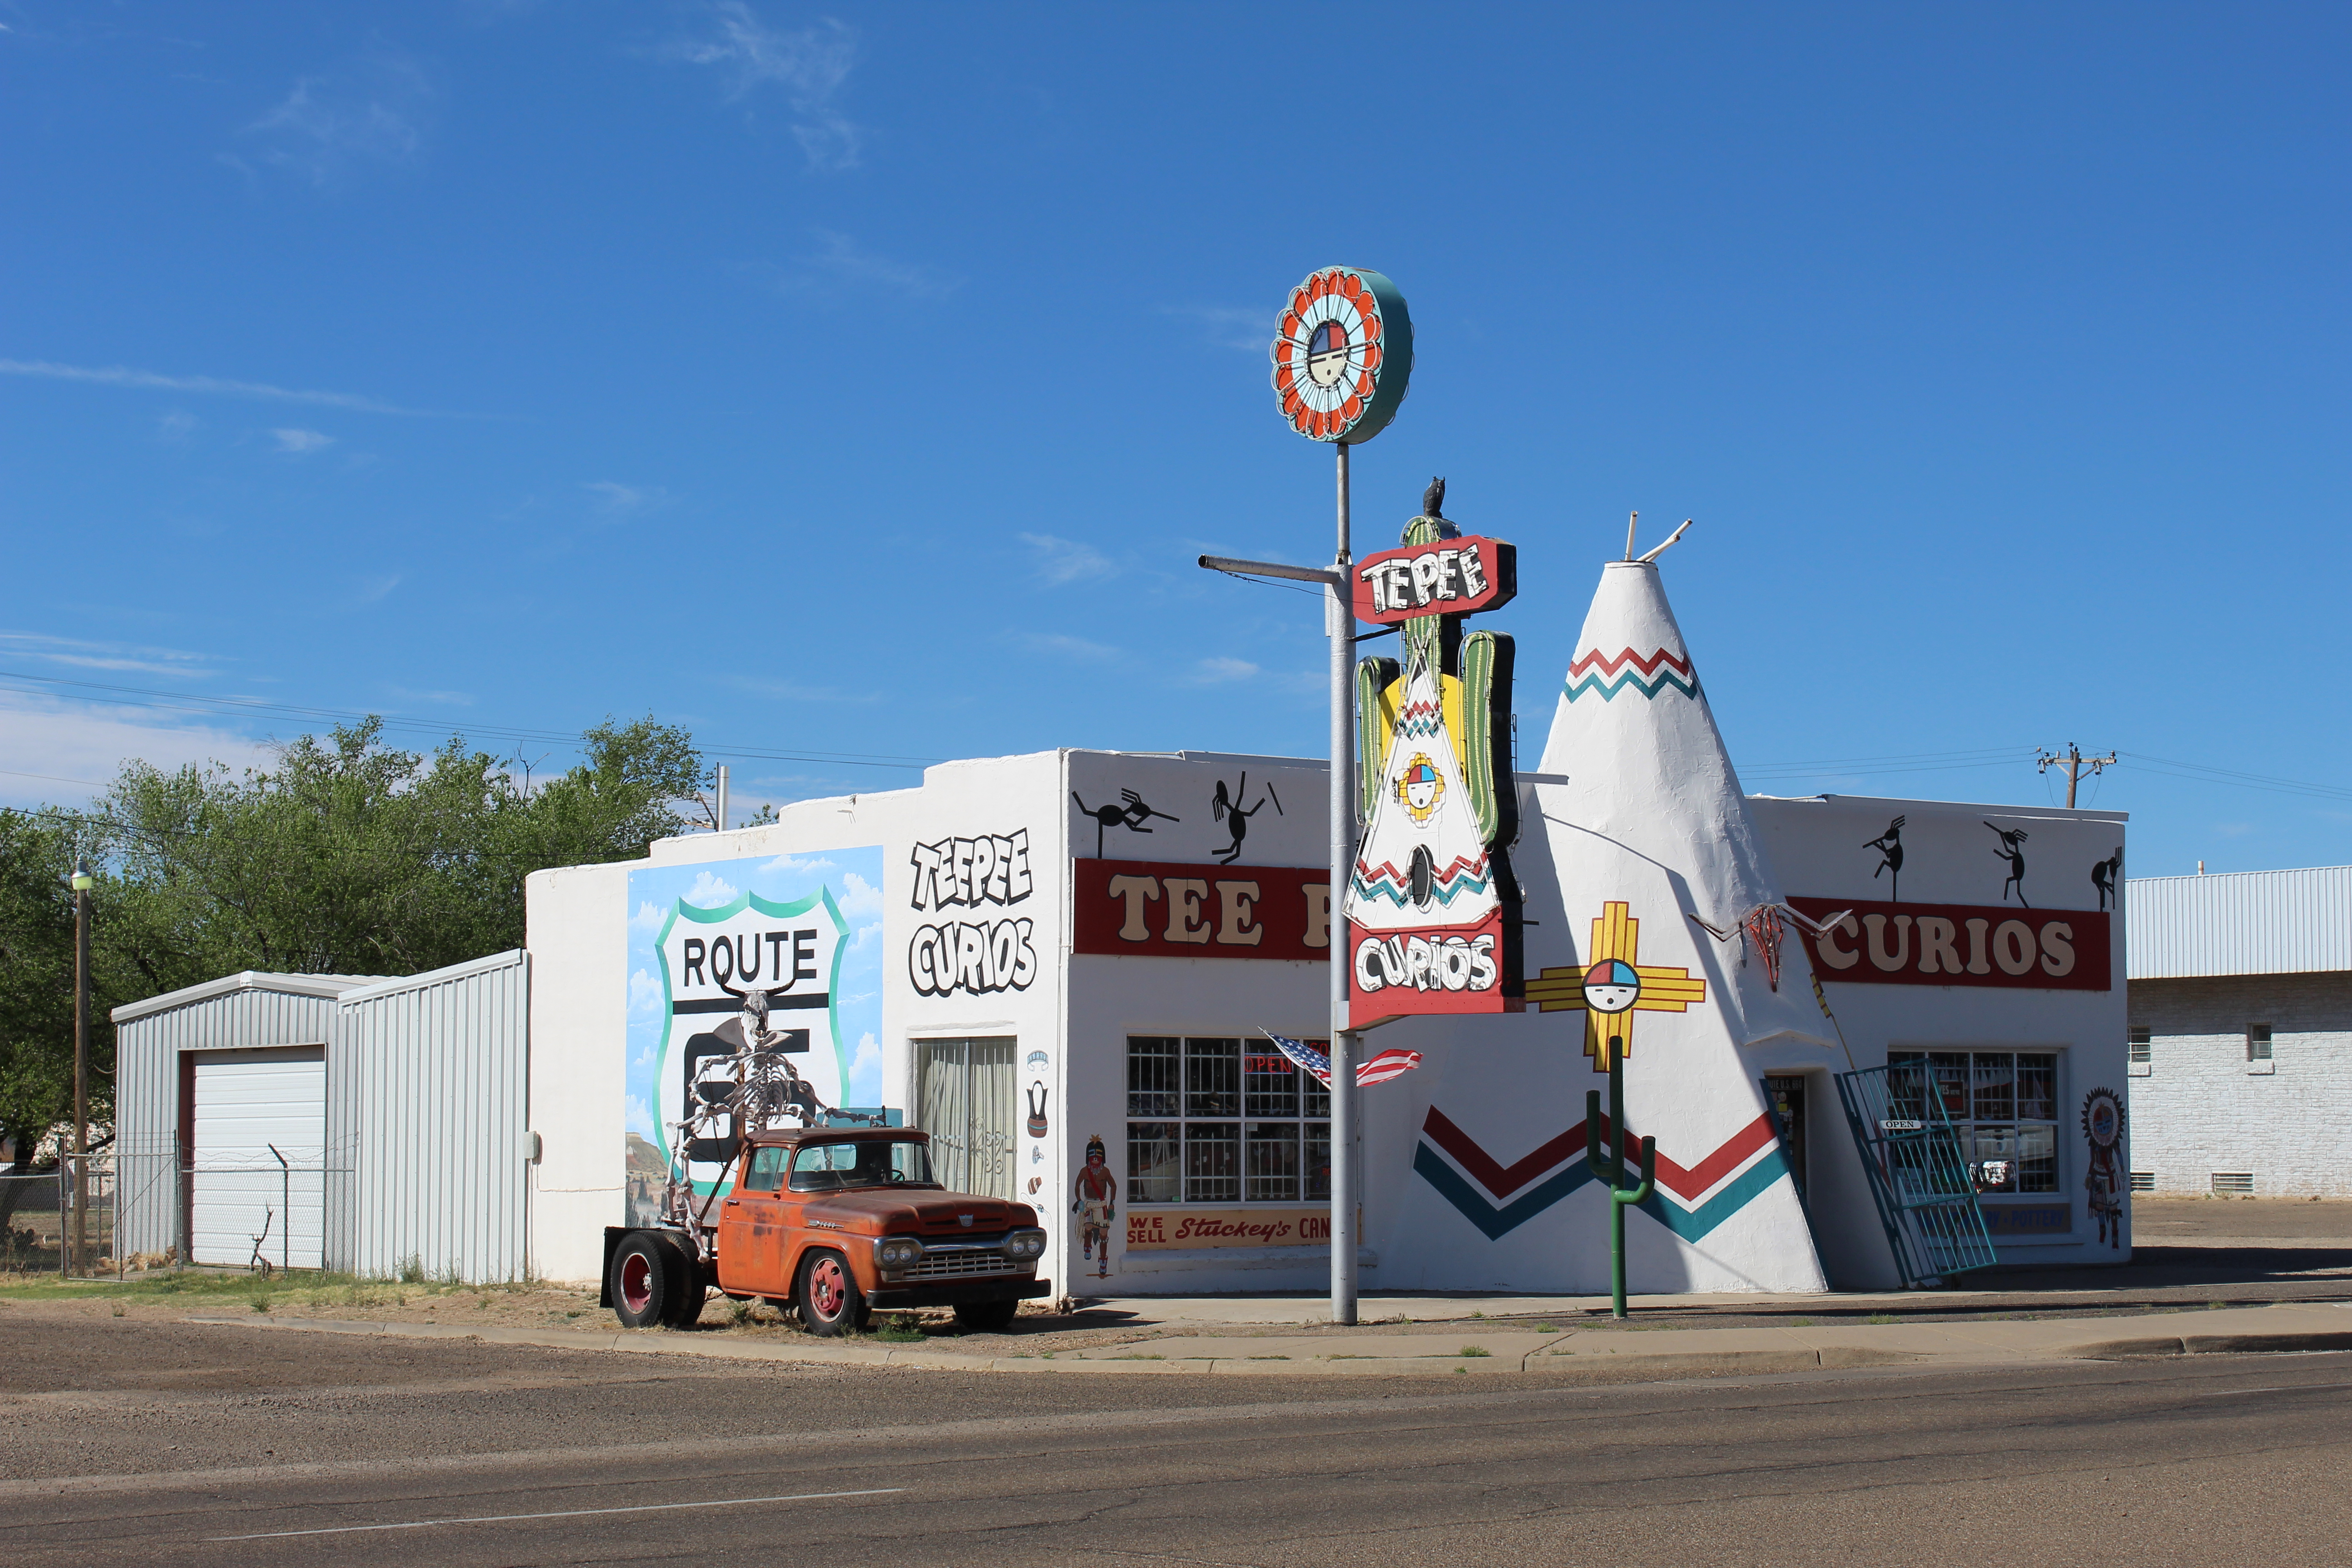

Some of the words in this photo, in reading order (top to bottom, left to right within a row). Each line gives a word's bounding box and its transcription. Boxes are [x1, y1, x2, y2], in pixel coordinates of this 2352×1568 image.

[1361, 544, 1488, 615] TEPEE
[911, 828, 1033, 911] TEEPEE
[1108, 873, 1264, 947] TEE
[684, 929, 817, 987] ROUTE
[909, 917, 1037, 997] CURIOS
[1354, 933, 1497, 993] CURIOS
[1816, 911, 2076, 977] CURIOS
[1245, 1056, 1292, 1073] OPEN
[1127, 1229, 1166, 1244] SELL
[1129, 1217, 1163, 1229] WE
[1175, 1217, 1292, 1243] Stuckey's
[2011, 1209, 2065, 1227] POTTERY
